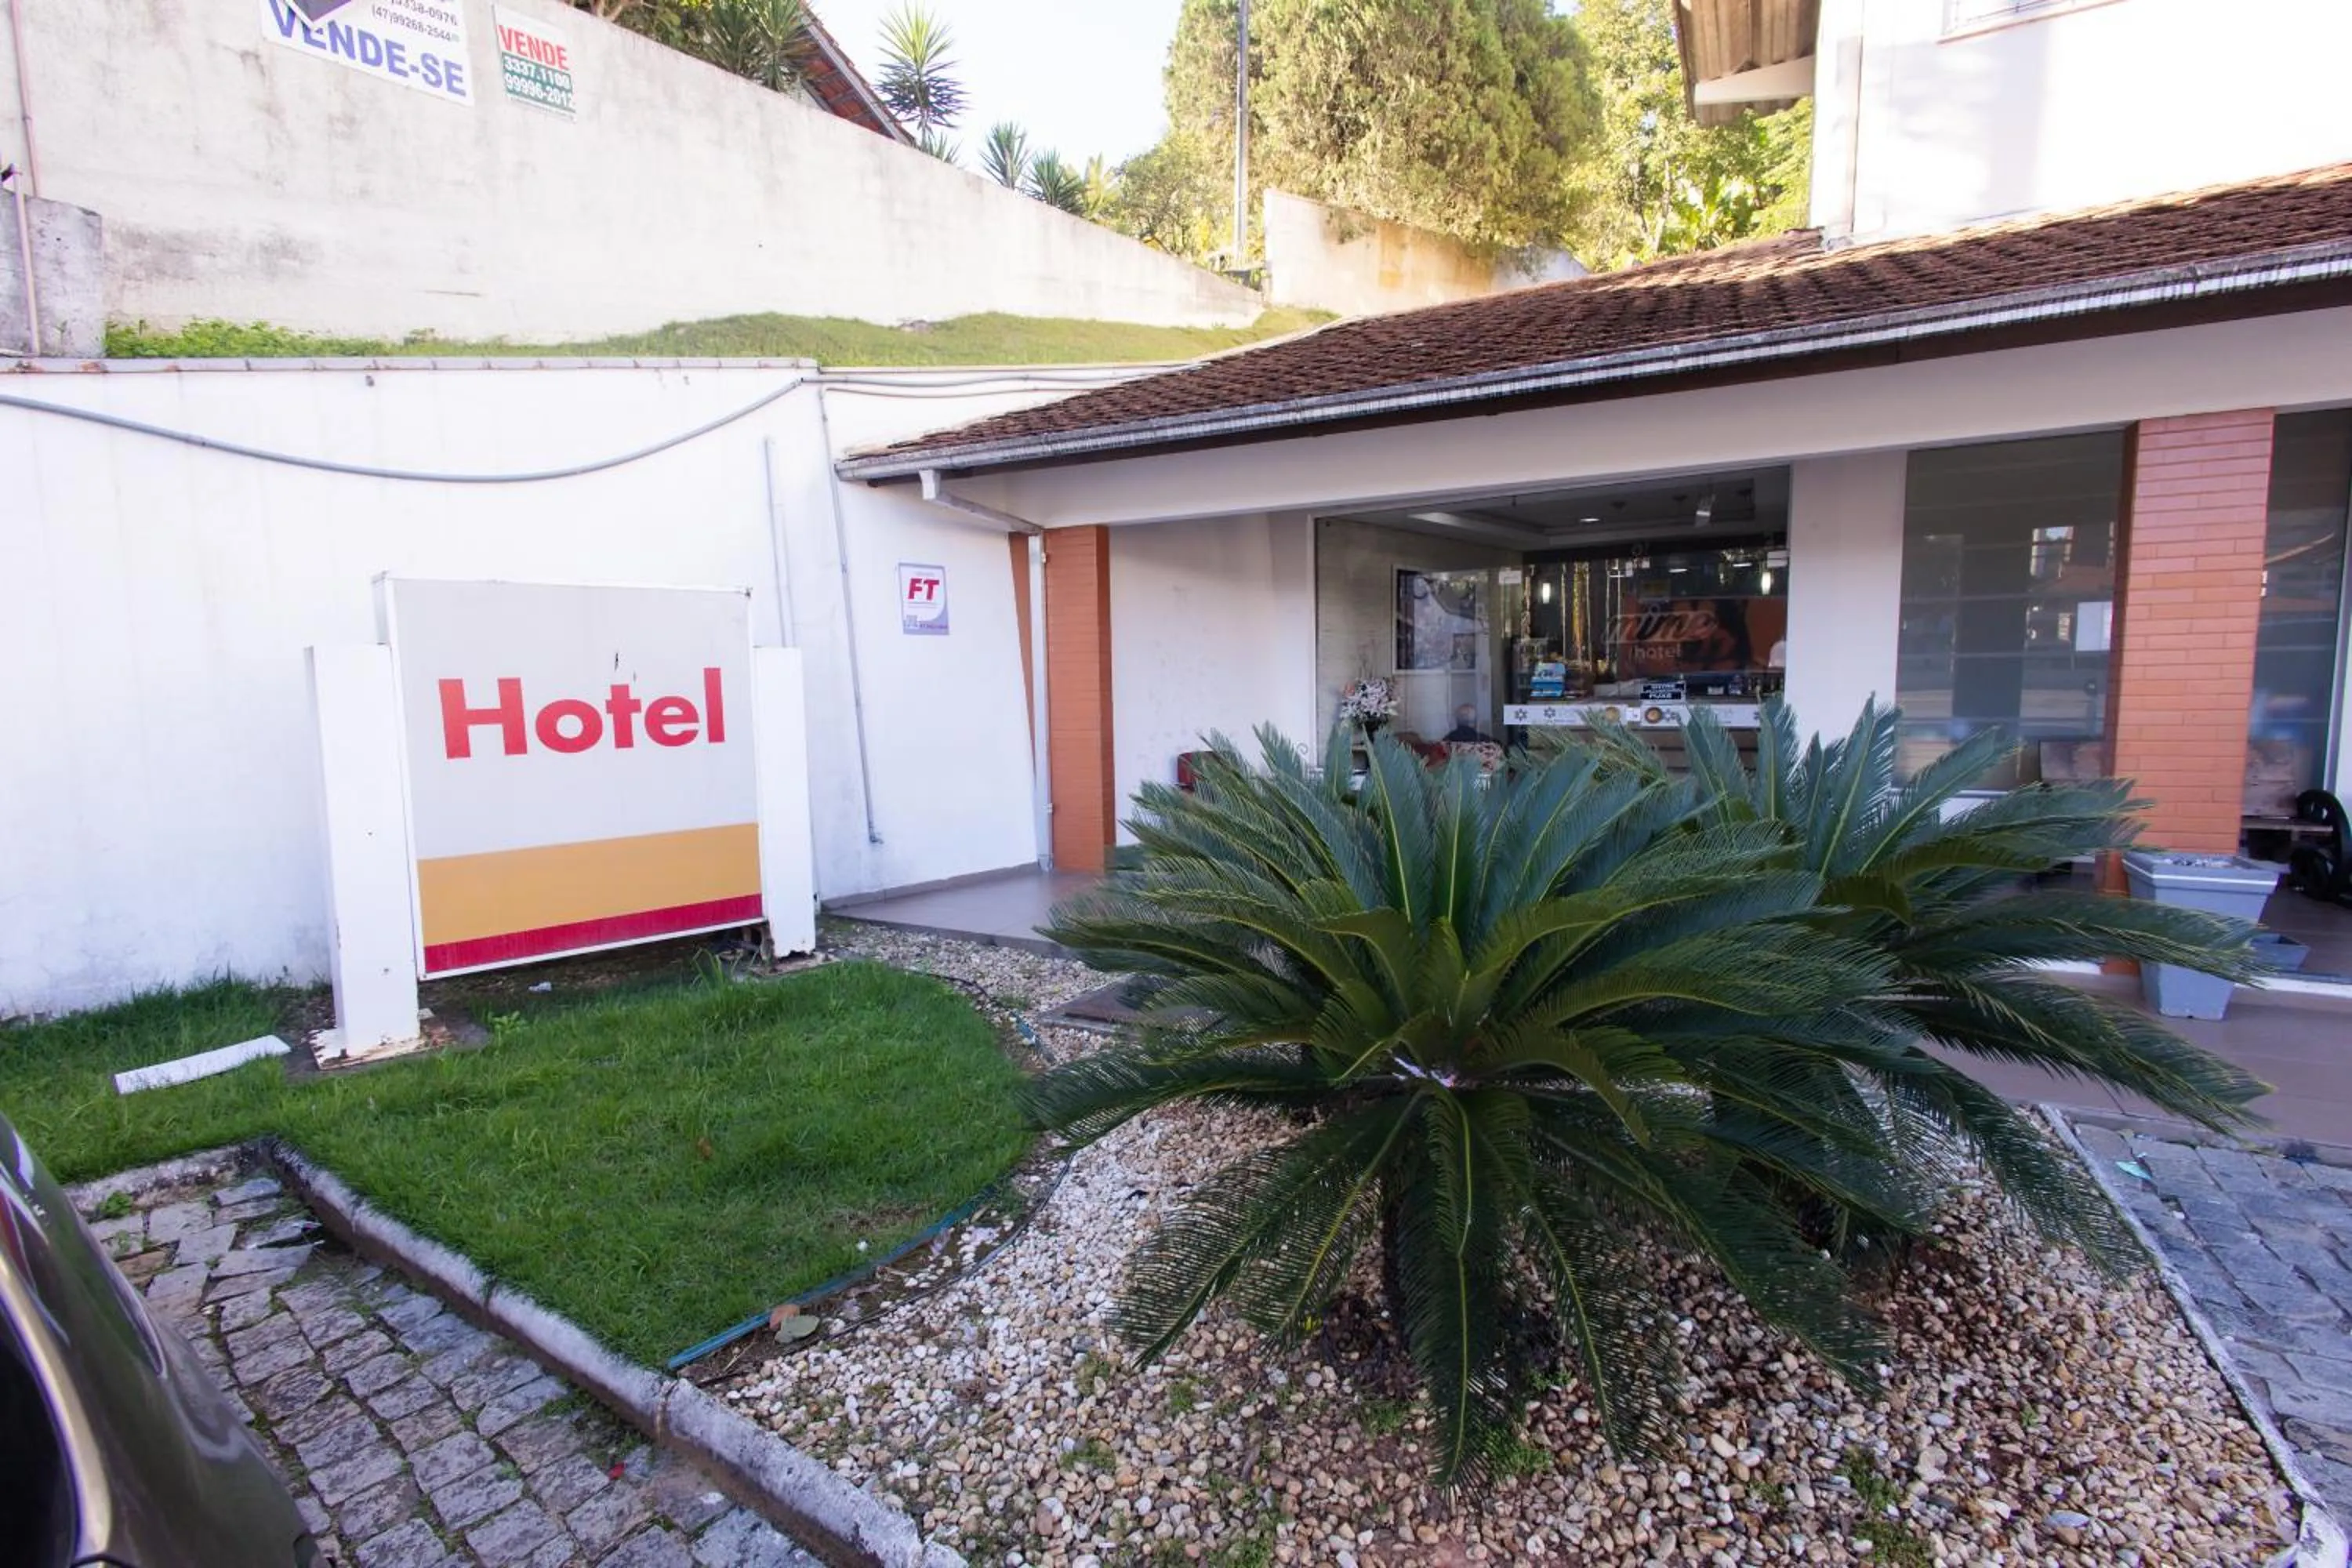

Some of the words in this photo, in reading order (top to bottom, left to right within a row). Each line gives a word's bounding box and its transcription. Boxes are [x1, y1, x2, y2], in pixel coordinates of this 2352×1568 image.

[269, 0, 466, 97] VENDE-SE
[496, 24, 569, 71] VENDE
[908, 578, 939, 601] FT
[1635, 643, 1682, 659] hotel
[438, 667, 725, 759] Hotel
